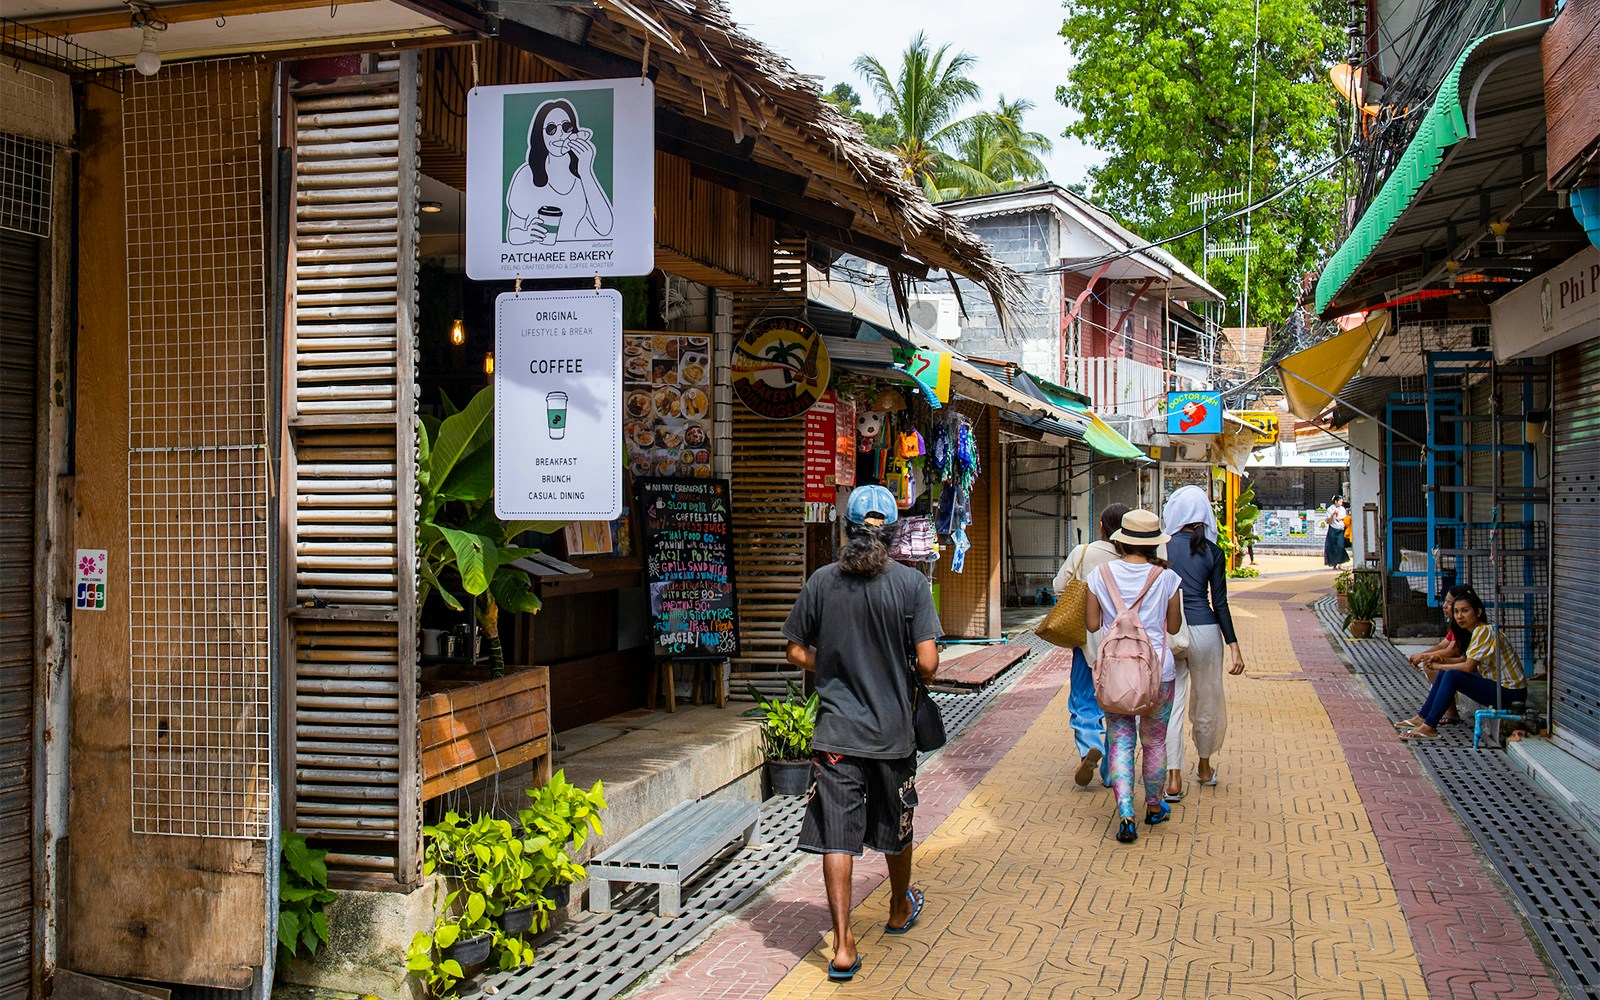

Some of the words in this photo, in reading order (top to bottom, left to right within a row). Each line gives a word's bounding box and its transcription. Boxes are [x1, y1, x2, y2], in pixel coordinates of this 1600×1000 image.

[501, 252, 566, 263] PATCHAREE
[569, 251, 614, 261] BAKERY
[1560, 271, 1585, 309] Phi
[536, 311, 578, 321] ORIGINAL
[521, 328, 559, 337] LIFESTYLE
[561, 328, 566, 336] &
[569, 327, 593, 336] BREAK
[530, 359, 583, 374] COFFEE
[752, 381, 796, 402] BAKERY
[734, 380, 812, 417] BOULANGERIE
[1168, 393, 1200, 409] DOCTOR
[1201, 394, 1219, 406] FISH
[535, 458, 578, 466] BREAKFAST
[541, 475, 571, 483] BRUNCH
[528, 492, 557, 500] CASUAL
[560, 492, 585, 500] DINING
[704, 523, 727, 535] JUICE
[661, 530, 681, 540] THAI
[683, 531, 701, 541] FOOD
[77, 591, 104, 601] JCB
